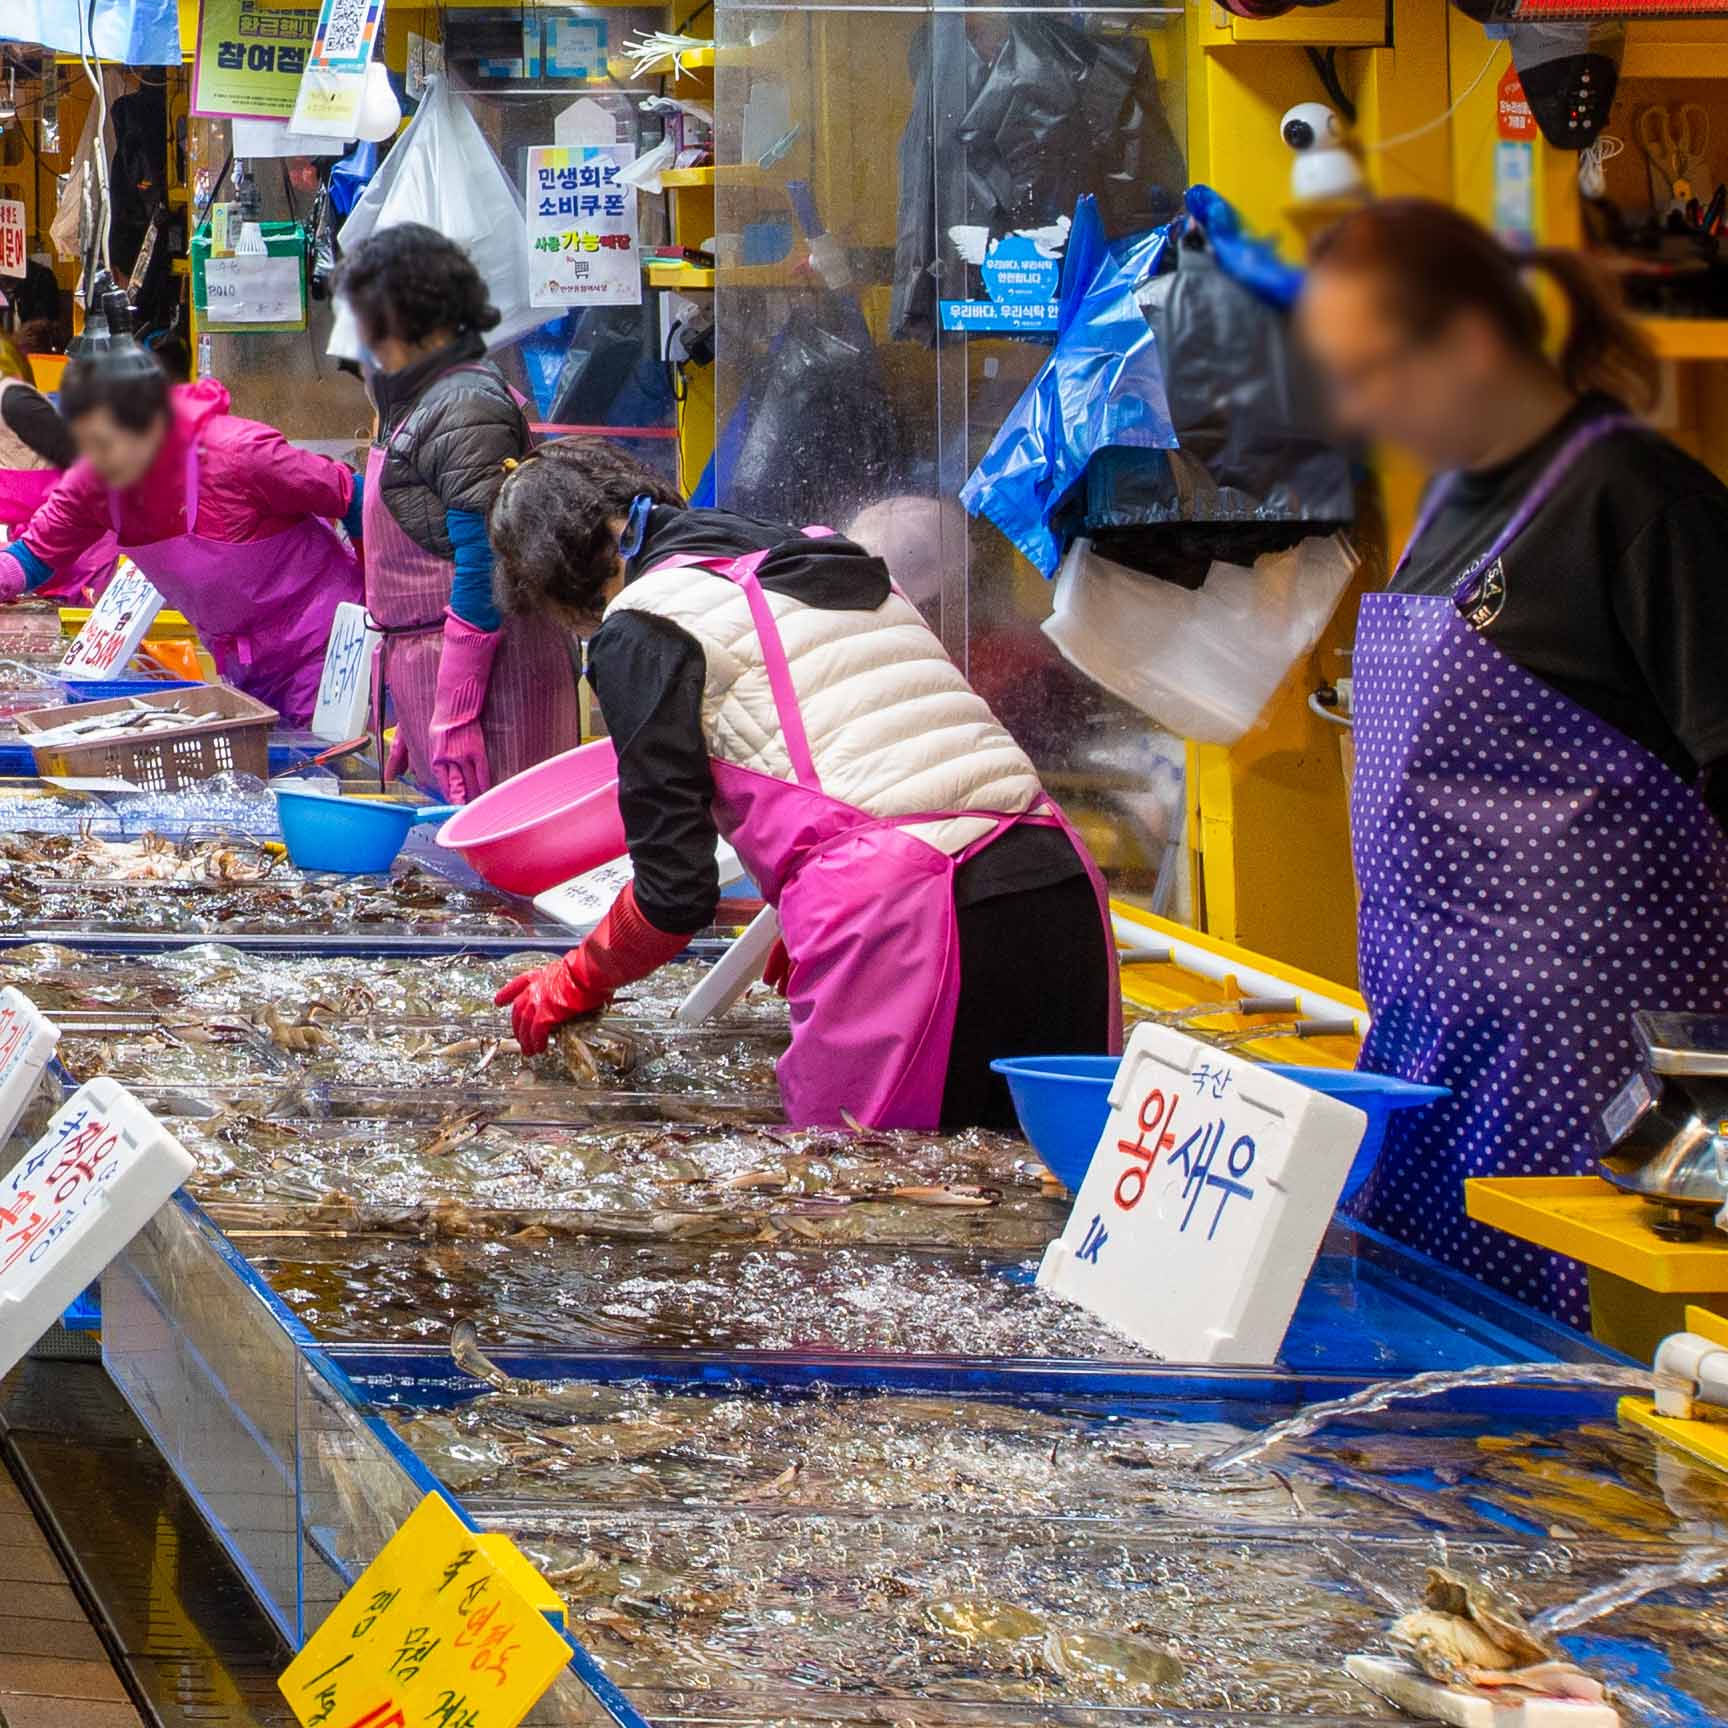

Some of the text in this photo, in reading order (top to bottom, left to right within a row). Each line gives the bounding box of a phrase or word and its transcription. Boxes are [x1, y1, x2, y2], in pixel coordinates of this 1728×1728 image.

[218, 41, 310, 74] 참여점
[539, 195, 624, 216] 소비쿠폰
[1191, 1064, 1233, 1100] 국산
[1113, 1087, 1257, 1242] 왕새우
